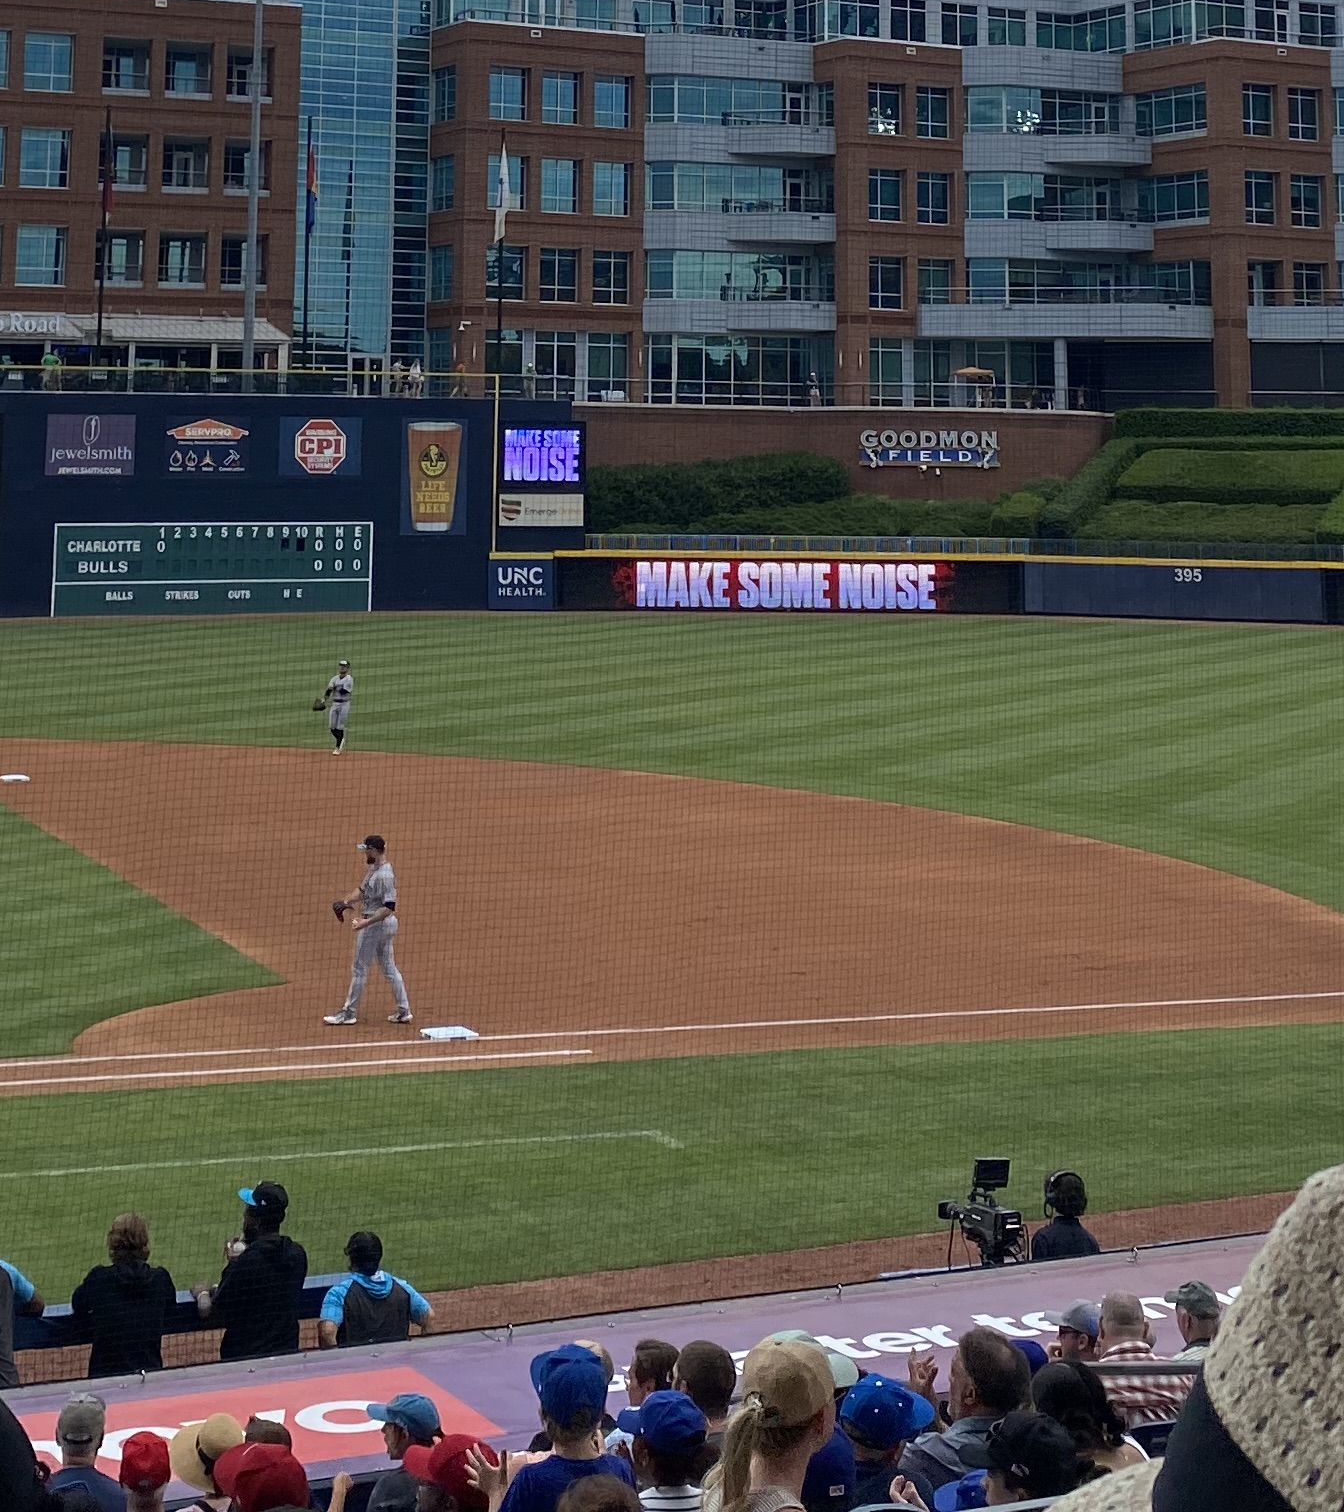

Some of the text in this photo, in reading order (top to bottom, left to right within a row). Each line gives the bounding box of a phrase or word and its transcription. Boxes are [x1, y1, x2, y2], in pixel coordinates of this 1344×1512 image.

[10, 312, 61, 332] Road
[184, 427, 233, 437] SERVPRO
[504, 429, 581, 447] MAKE SOME
[860, 429, 998, 448] GOODMON
[300, 438, 342, 454] CPI
[49, 444, 132, 463] jewelsmith
[888, 450, 972, 462] FIELD
[503, 446, 580, 481] NOISE
[421, 480, 446, 491] LIFE
[416, 492, 450, 502] NEEDS
[419, 503, 446, 513] BEER
[159, 526, 362, 538] 1 2 3 4 5 6 7 8 9 10 R H E
[67, 539, 362, 552] CHARLOTTE 0 0 0 0
[78, 559, 361, 573] BULLS 0 0 0
[498, 566, 543, 584] UNC
[1174, 568, 1202, 582] 395
[498, 588, 543, 596] HEALTH
[636, 561, 936, 610] MAKE SOME NOISE
[106, 589, 303, 600] BALLS STRIKES OUTS H E
